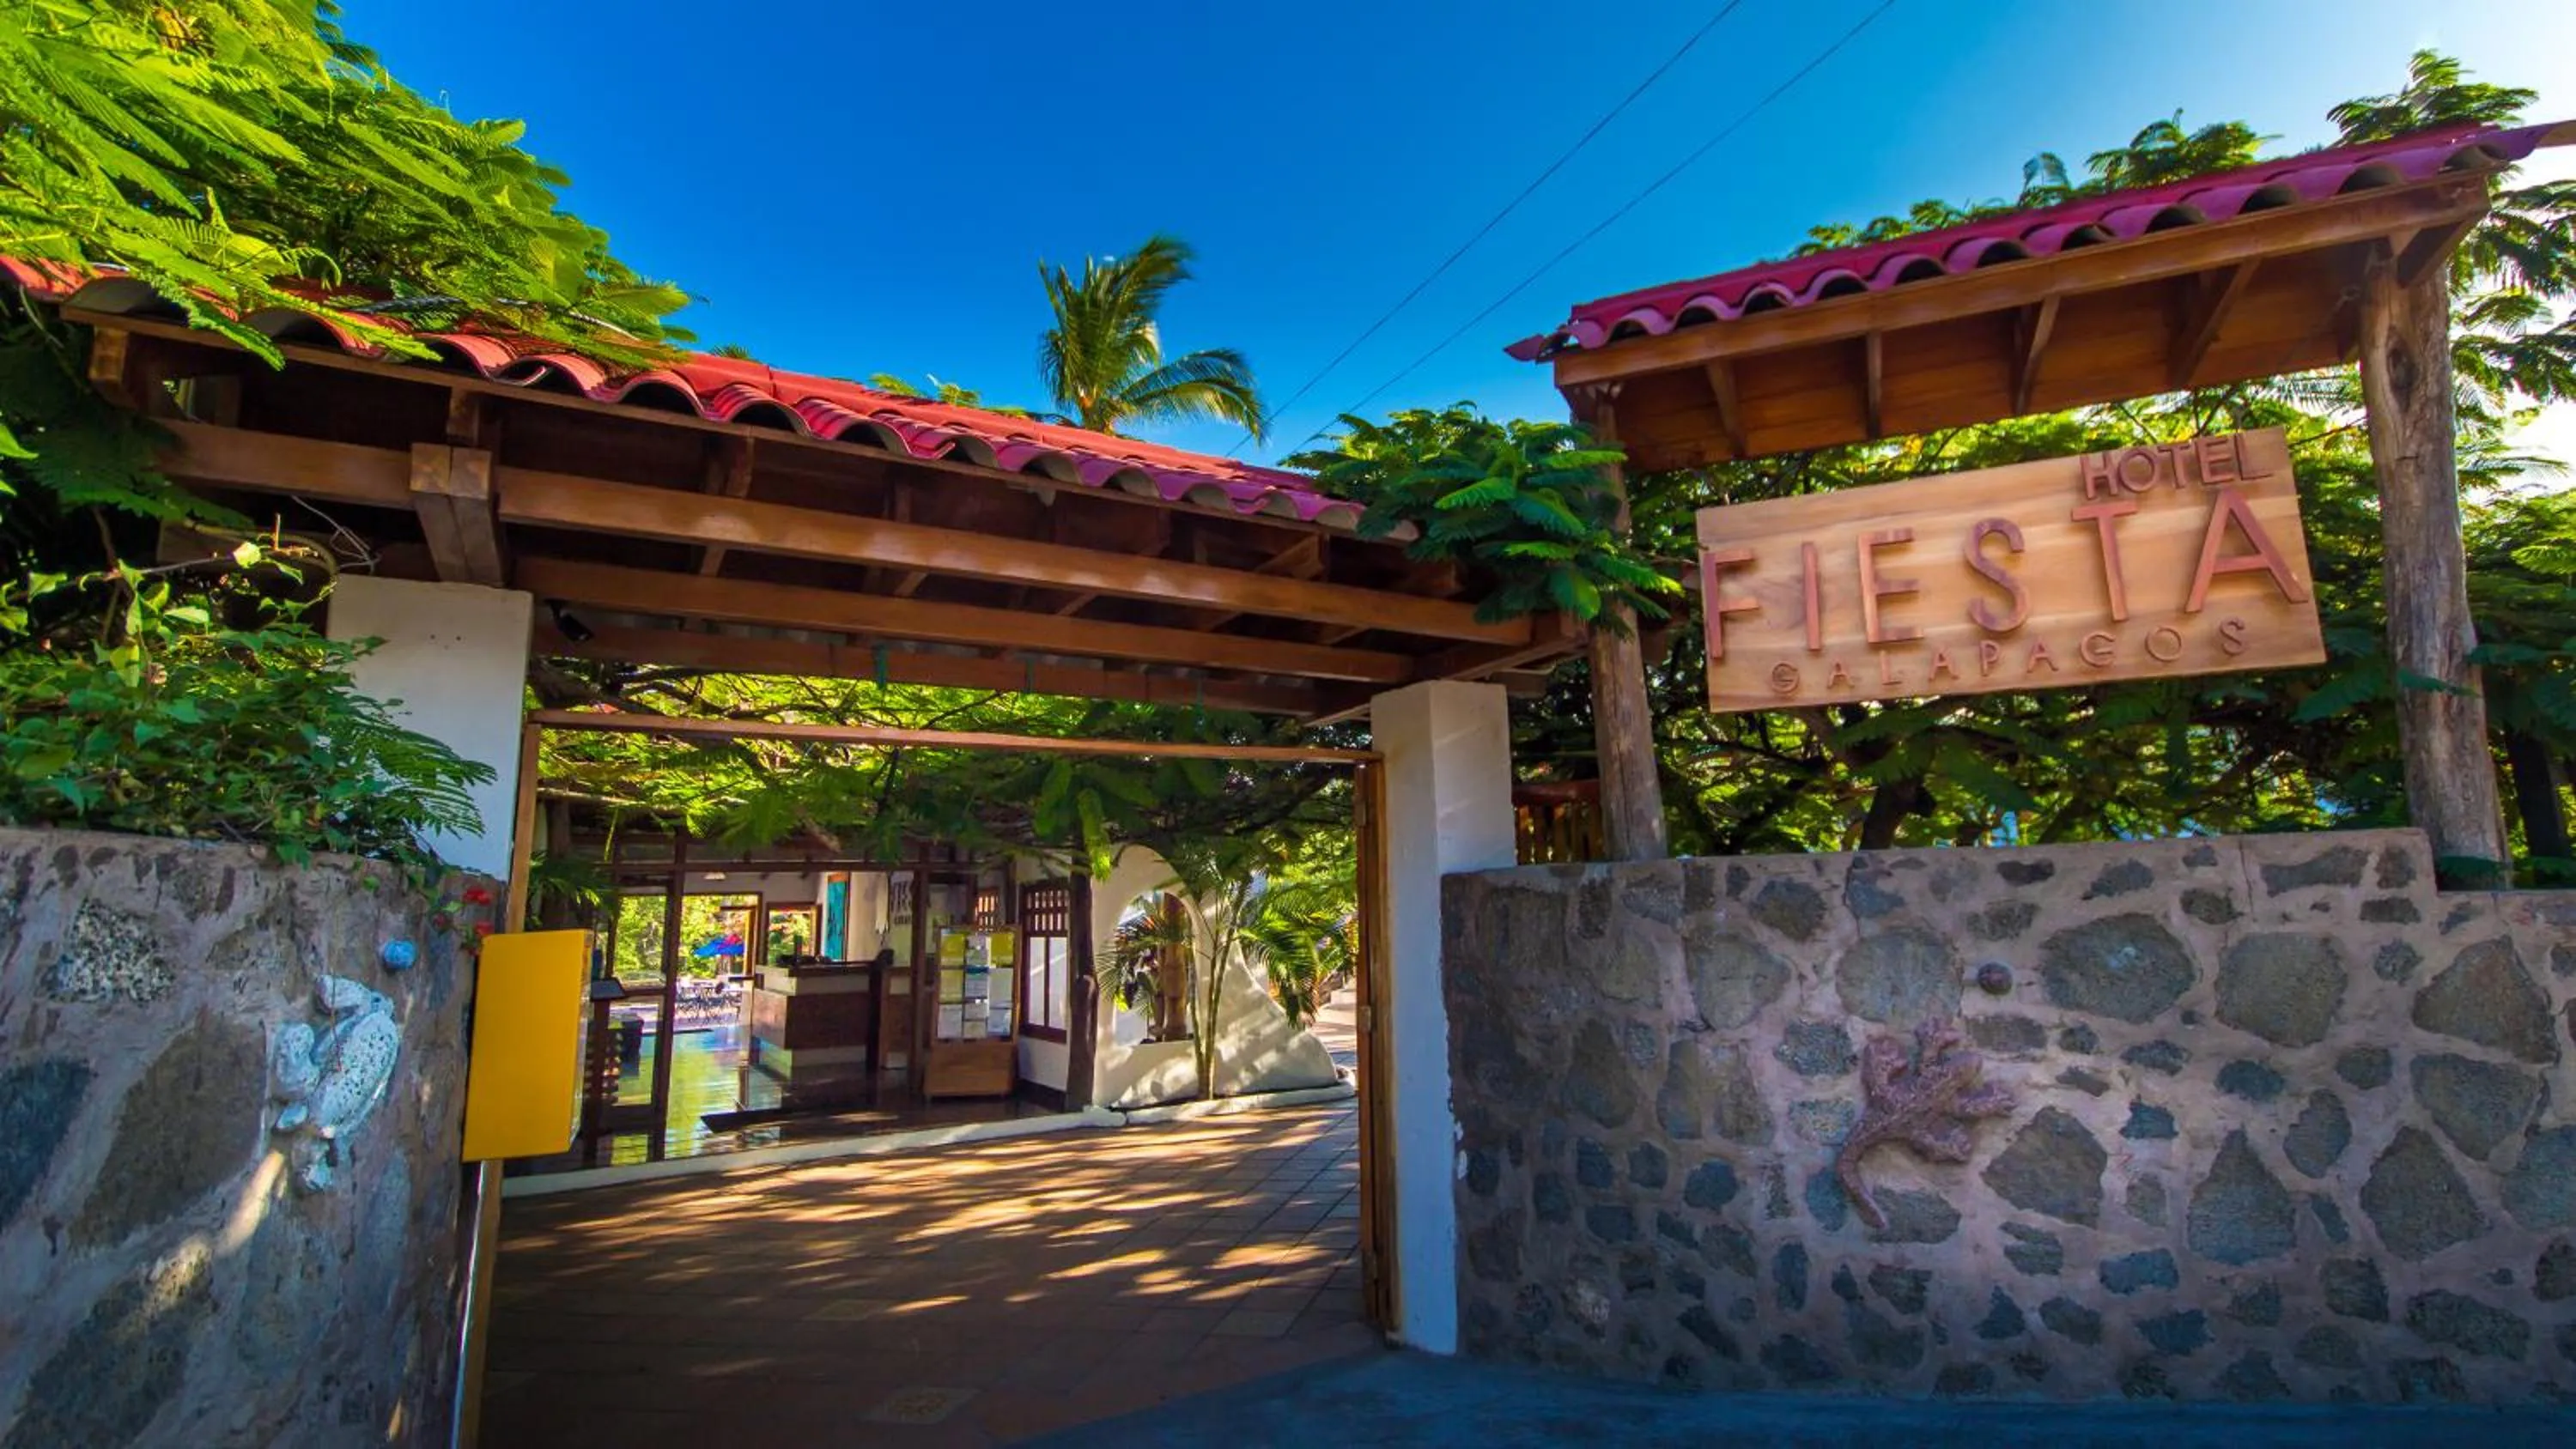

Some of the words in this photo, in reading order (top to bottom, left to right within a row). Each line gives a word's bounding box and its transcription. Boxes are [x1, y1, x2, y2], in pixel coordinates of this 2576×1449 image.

[2080, 433, 2273, 500] HOTEL
[1704, 488, 2308, 658] FIESTA
[1771, 618, 2246, 692] GALAPAGOS
